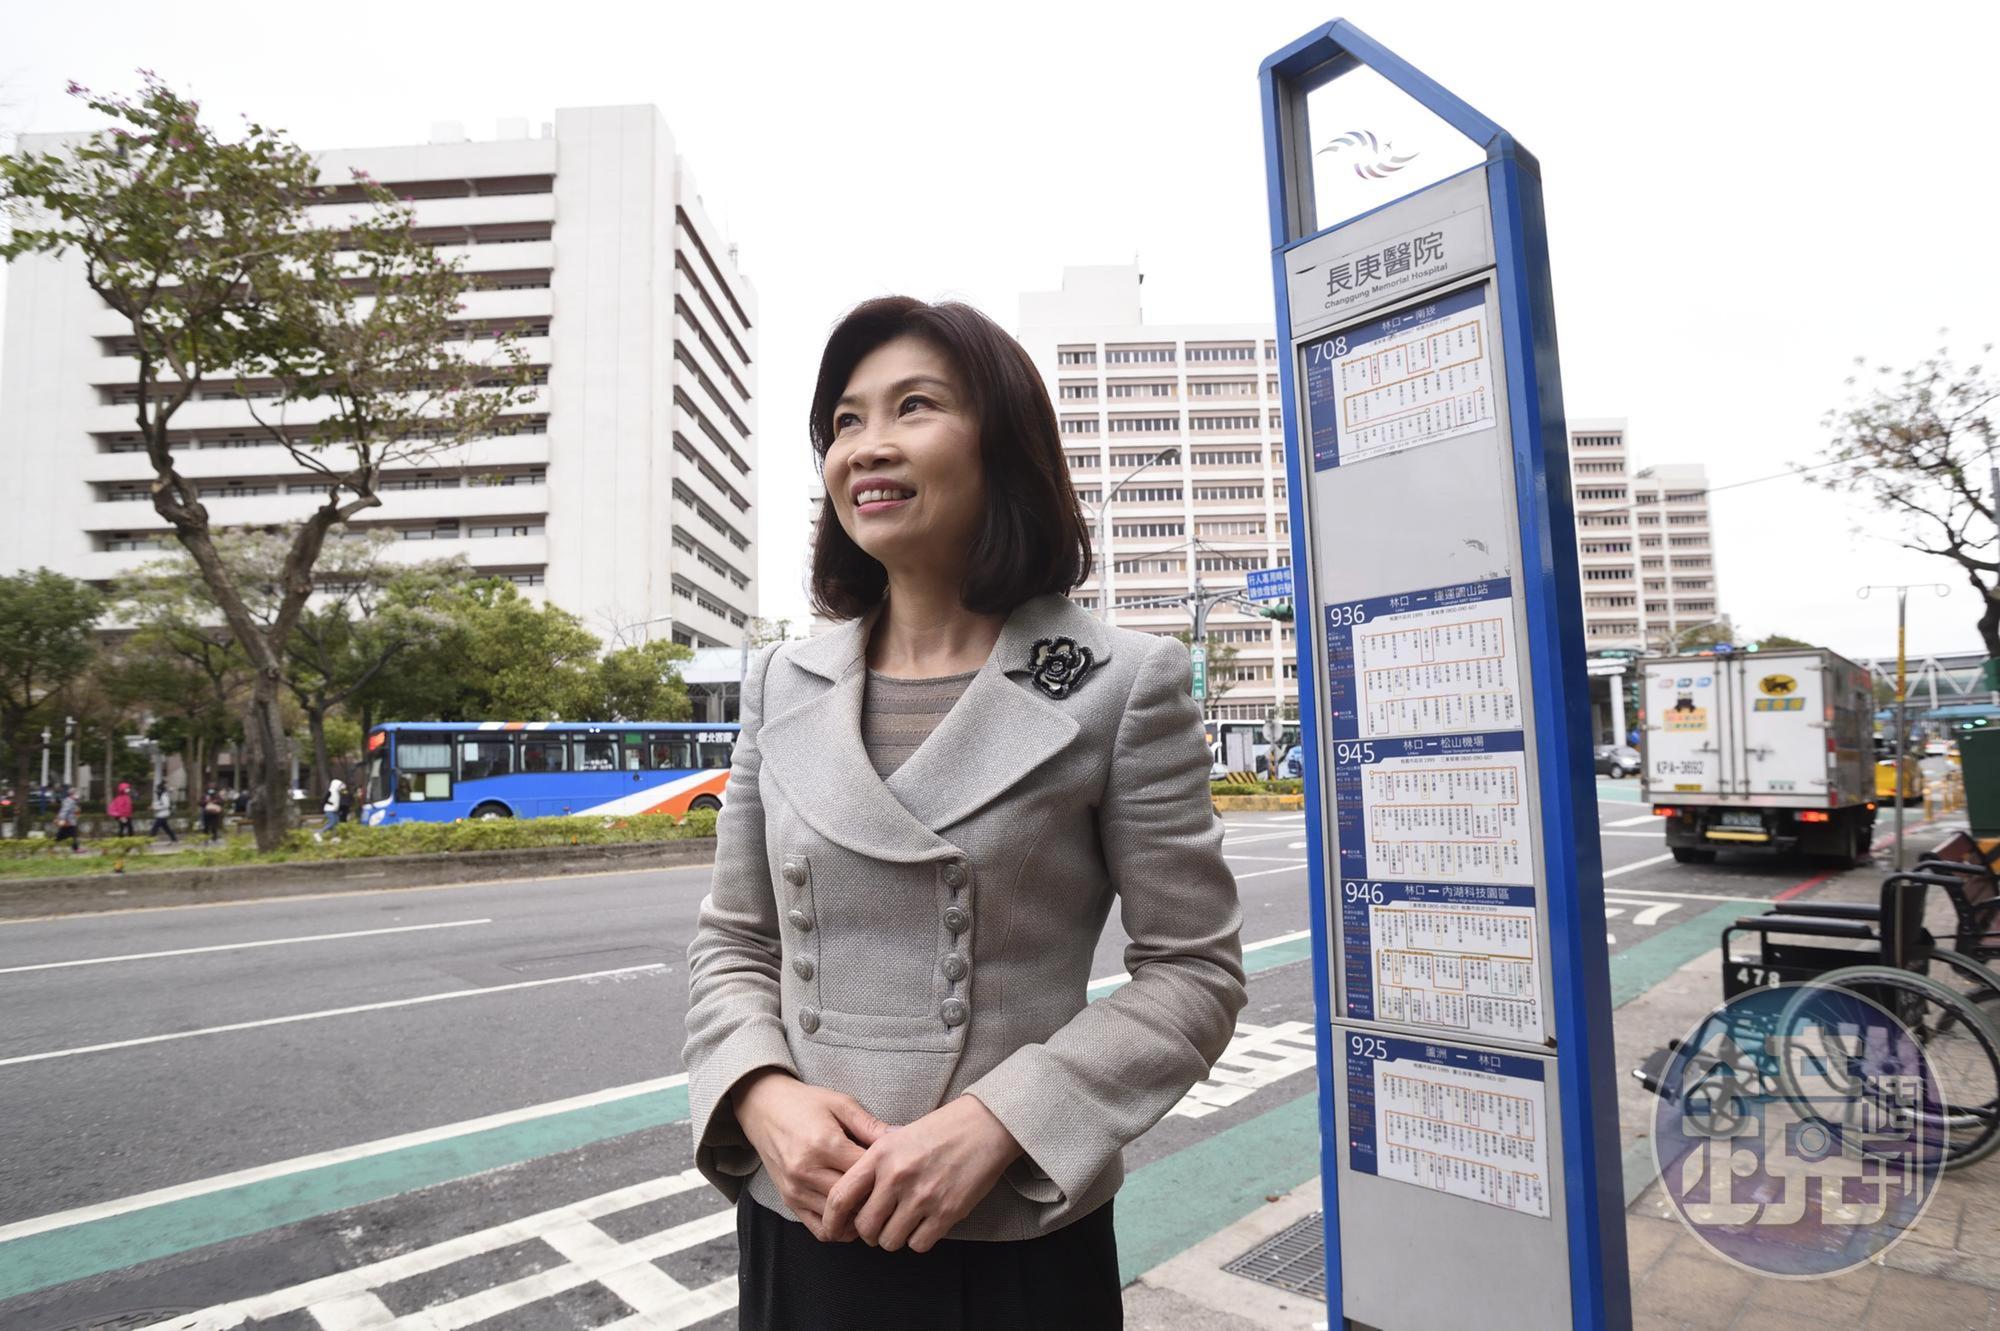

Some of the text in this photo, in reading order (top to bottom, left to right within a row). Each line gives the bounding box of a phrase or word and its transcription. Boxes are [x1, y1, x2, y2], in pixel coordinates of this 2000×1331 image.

[1326, 231, 1443, 298] 長庚醫院
[1324, 262, 1448, 309] Changgung Memorial Hospital
[1381, 317, 1401, 331] 林口
[1311, 336, 1348, 364] 708
[1389, 595, 1409, 608] 林口
[1331, 604, 1365, 627] 936
[1337, 742, 1375, 764] 945
[1403, 739, 1424, 750] 林口
[1440, 736, 1484, 749] 松山機場
[1345, 882, 1384, 905] 946
[1404, 885, 1426, 896] 林口
[1737, 967, 1780, 989] 478
[1351, 1035, 1388, 1059] 925
[1478, 1054, 1501, 1068] 林口
